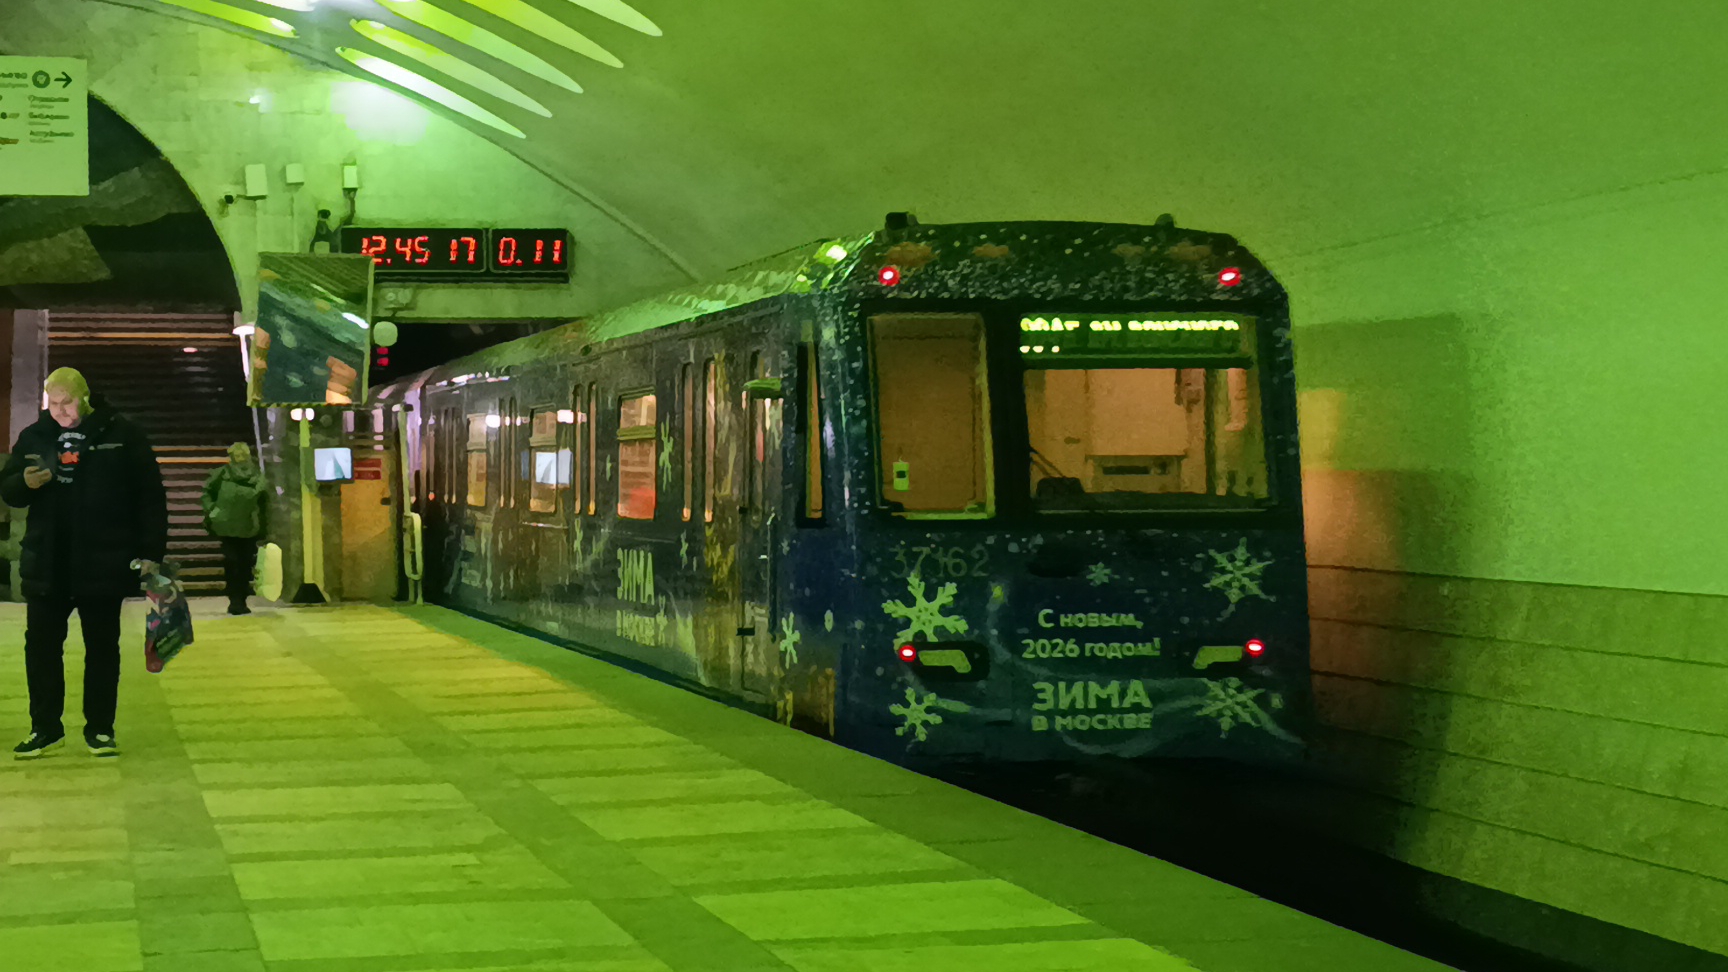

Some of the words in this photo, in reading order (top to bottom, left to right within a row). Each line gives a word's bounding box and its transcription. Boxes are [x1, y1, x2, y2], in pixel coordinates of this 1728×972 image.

[449, 236, 477, 265] 17
[616, 547, 655, 606] ЗИМА
[888, 545, 990, 579] 37162
[1020, 637, 1081, 659] 2026
[1031, 678, 1154, 711] ЗИМА
